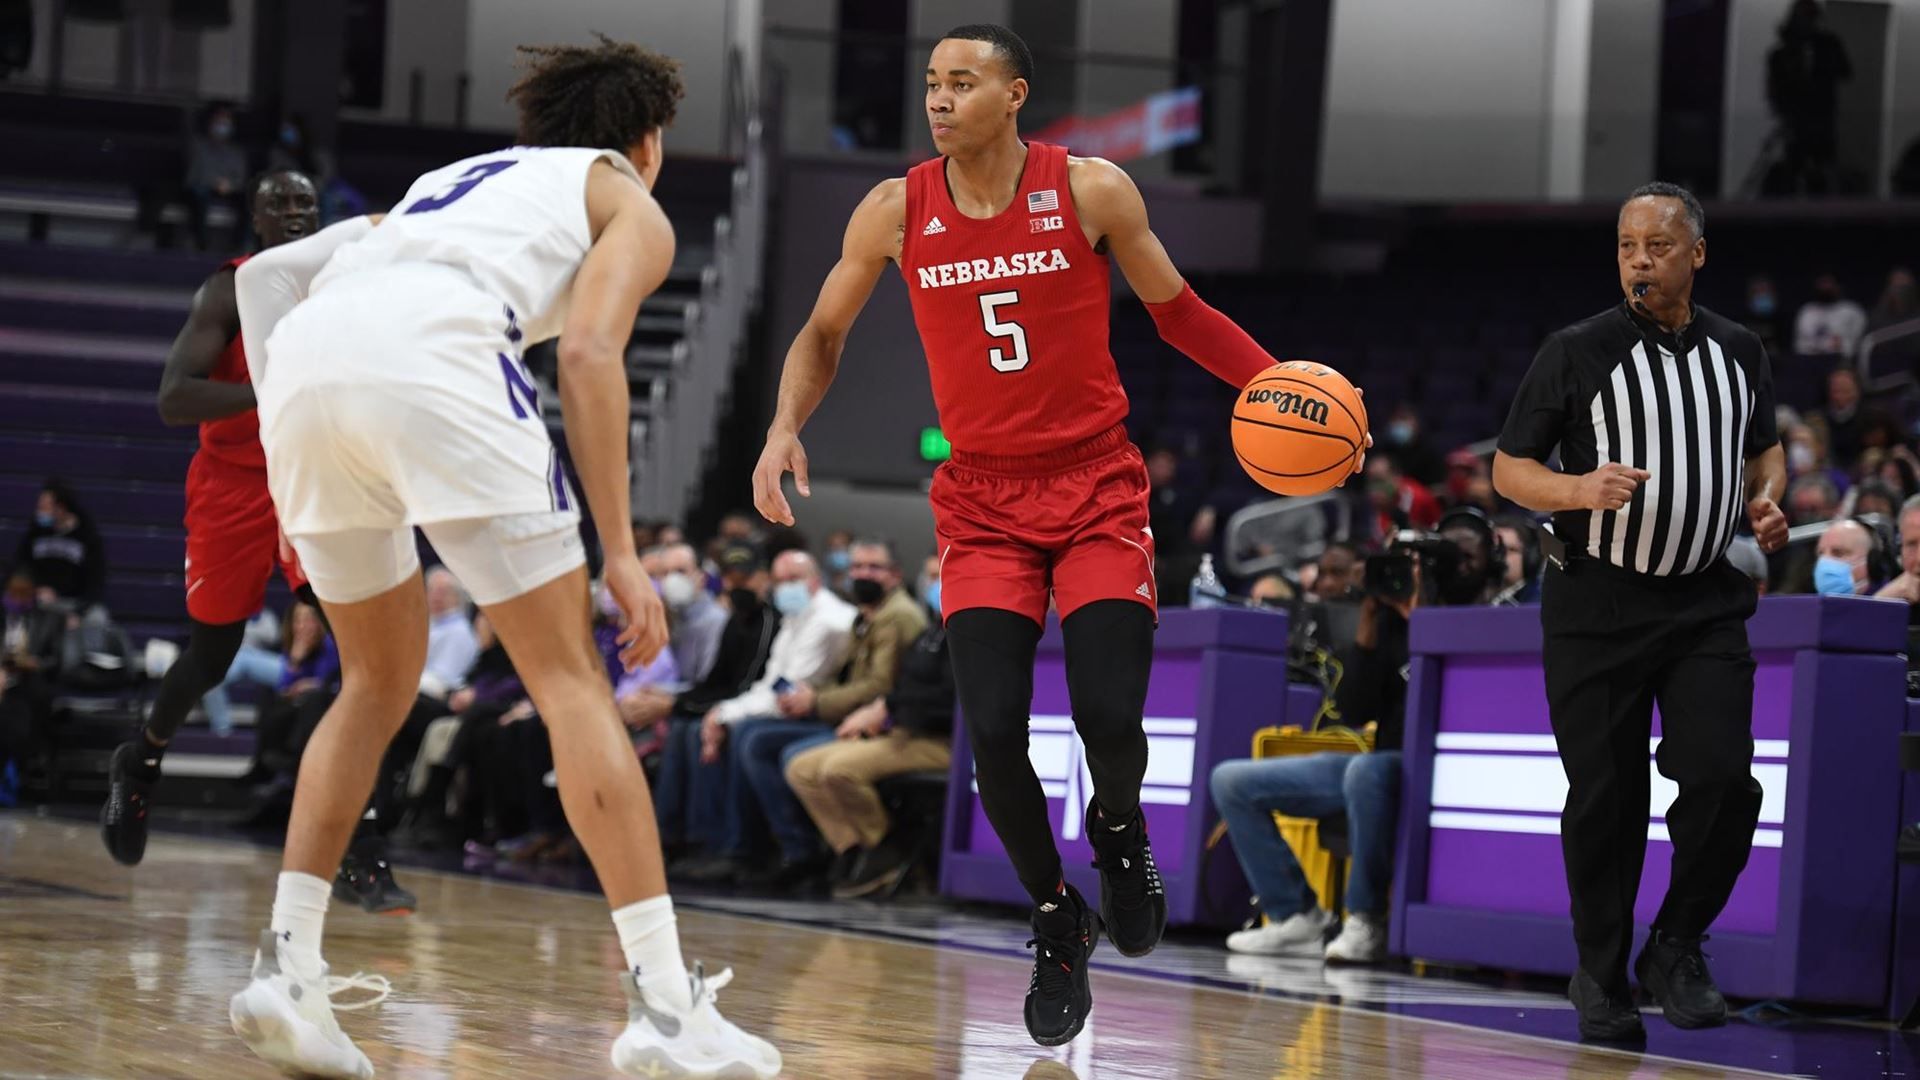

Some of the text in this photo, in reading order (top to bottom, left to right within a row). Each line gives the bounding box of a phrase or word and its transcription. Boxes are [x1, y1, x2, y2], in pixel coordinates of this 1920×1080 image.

[404, 160, 519, 215] 3
[917, 248, 1070, 288] NEBRASKA
[978, 290, 1029, 373] 5
[1246, 389, 1330, 426] Wilson
